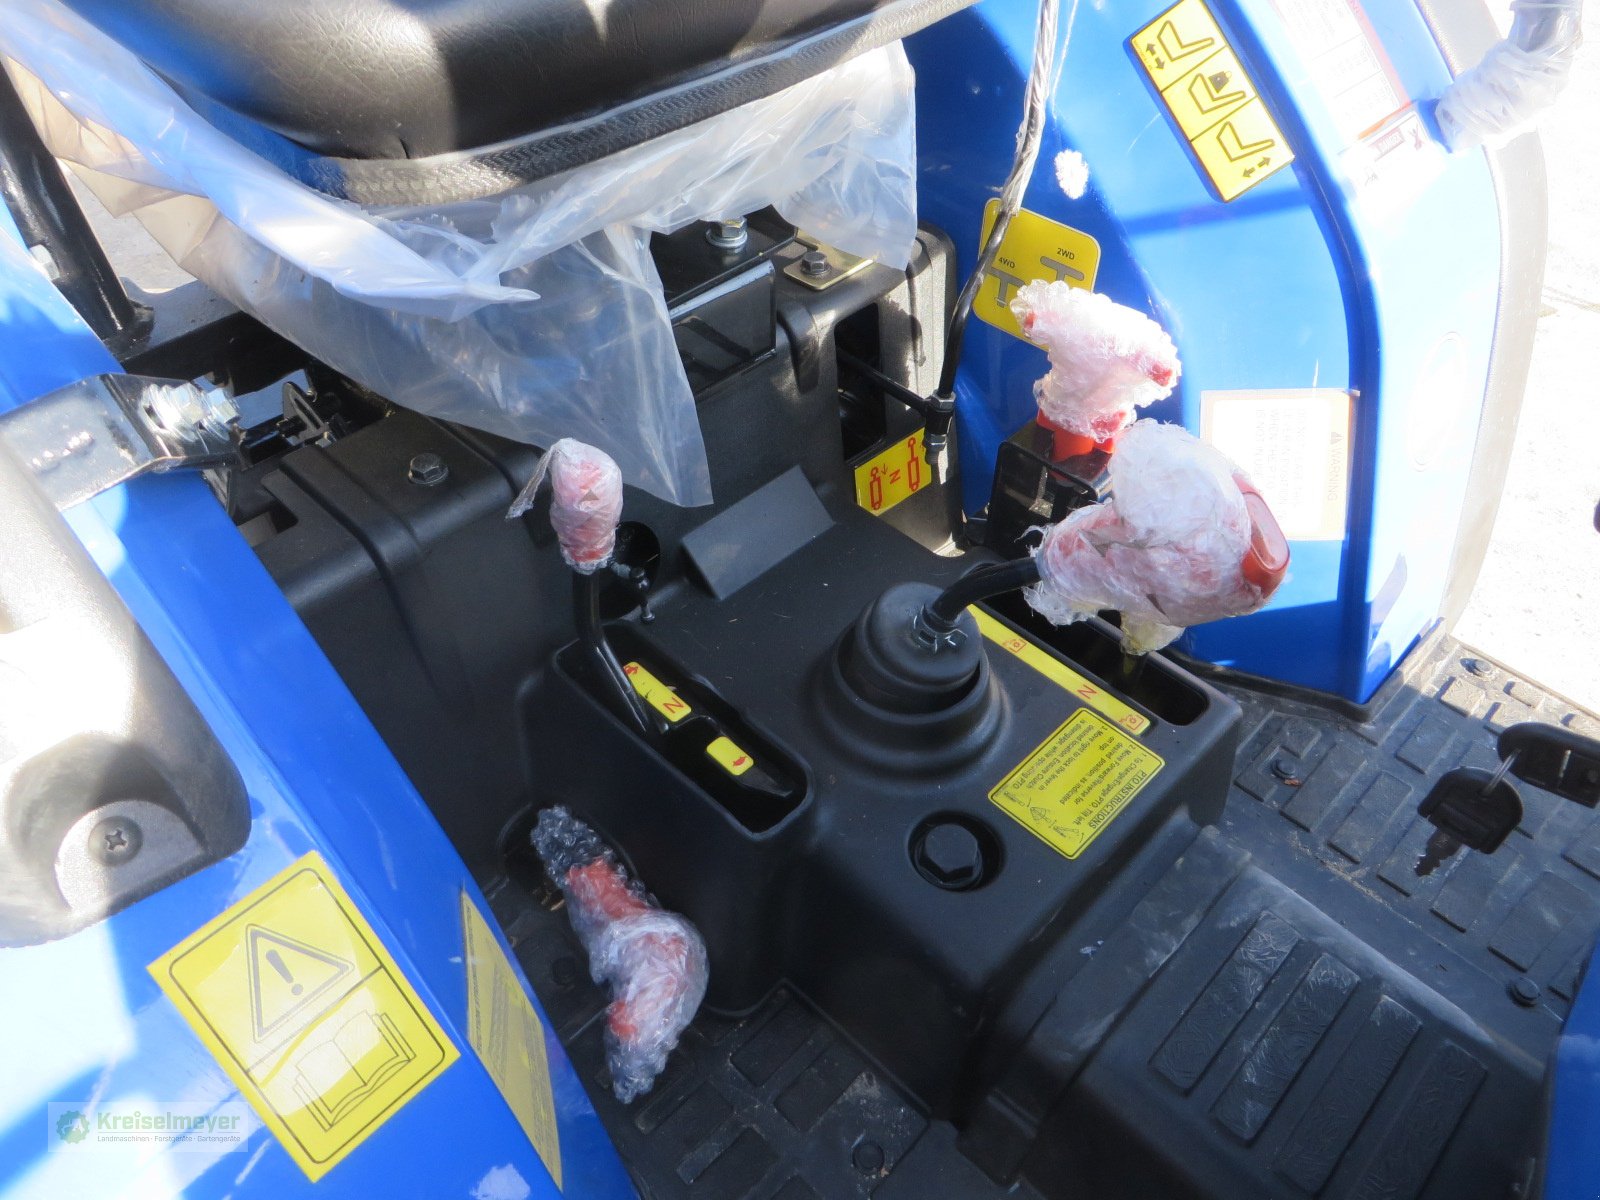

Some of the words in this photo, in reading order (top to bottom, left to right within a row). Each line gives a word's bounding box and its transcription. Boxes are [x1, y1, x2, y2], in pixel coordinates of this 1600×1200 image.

[1056, 247, 1075, 260] 2WD
[998, 257, 1016, 269] 4WD
[889, 468, 901, 485] N
[1327, 448, 1341, 501] WARNING
[1077, 684, 1098, 700] N
[663, 696, 685, 714] N
[1105, 742, 1123, 759] desired
[1041, 757, 1060, 775] Ensure
[1026, 772, 1044, 790] Clutch
[1081, 760, 1120, 799] Forward/Reverse
[1100, 761, 1137, 798] Change/Engage
[1131, 770, 1147, 785] PTO
[1059, 782, 1082, 805] indicated
[1088, 782, 1134, 830] INSTRUCTIONS
